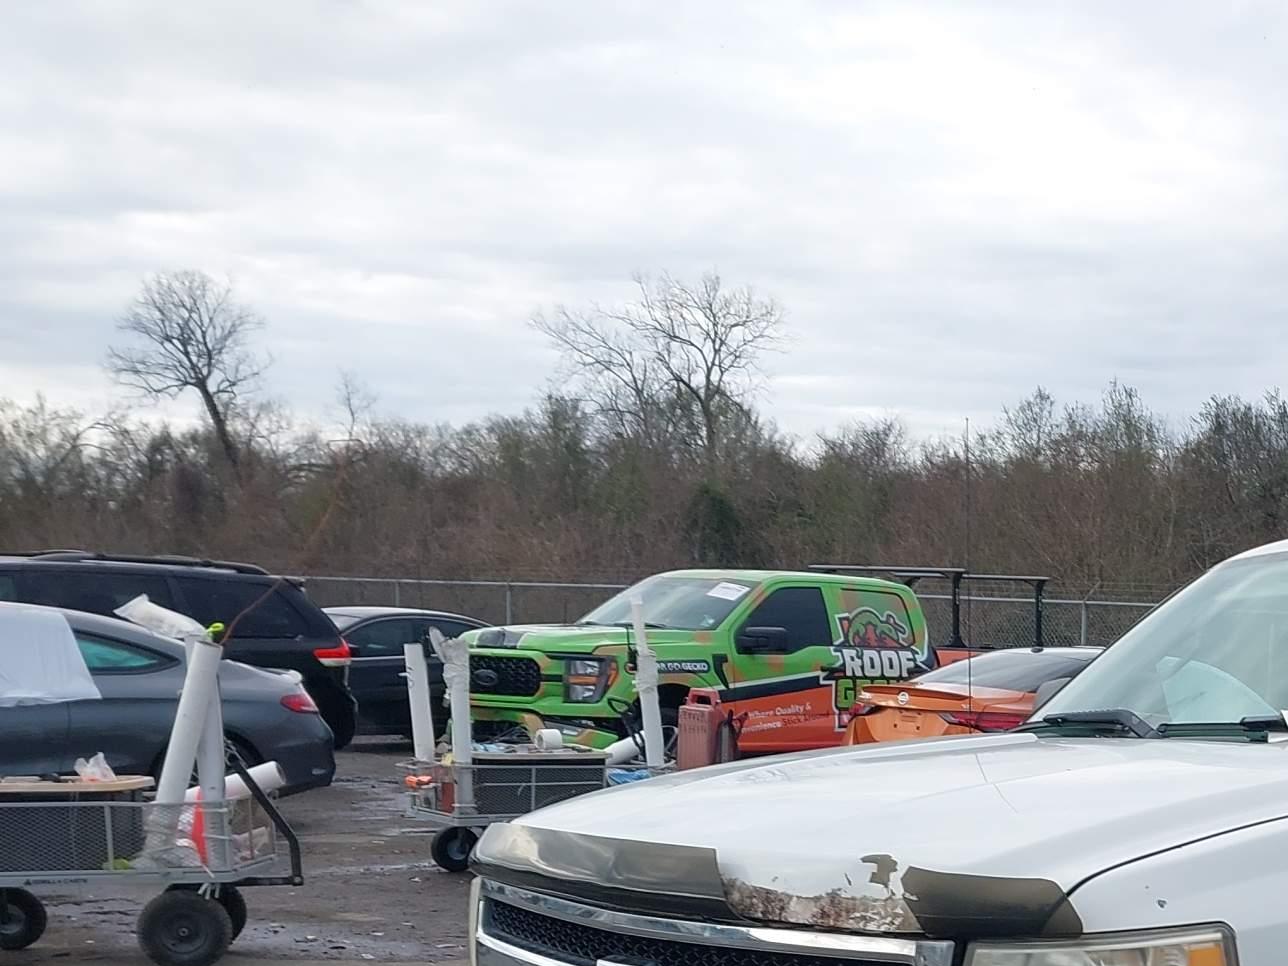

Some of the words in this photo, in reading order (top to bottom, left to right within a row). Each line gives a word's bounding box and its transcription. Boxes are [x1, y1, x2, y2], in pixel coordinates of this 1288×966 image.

[842, 649, 915, 678] ROOF
[775, 703, 804, 716] Quality
[805, 702, 812, 711] &
